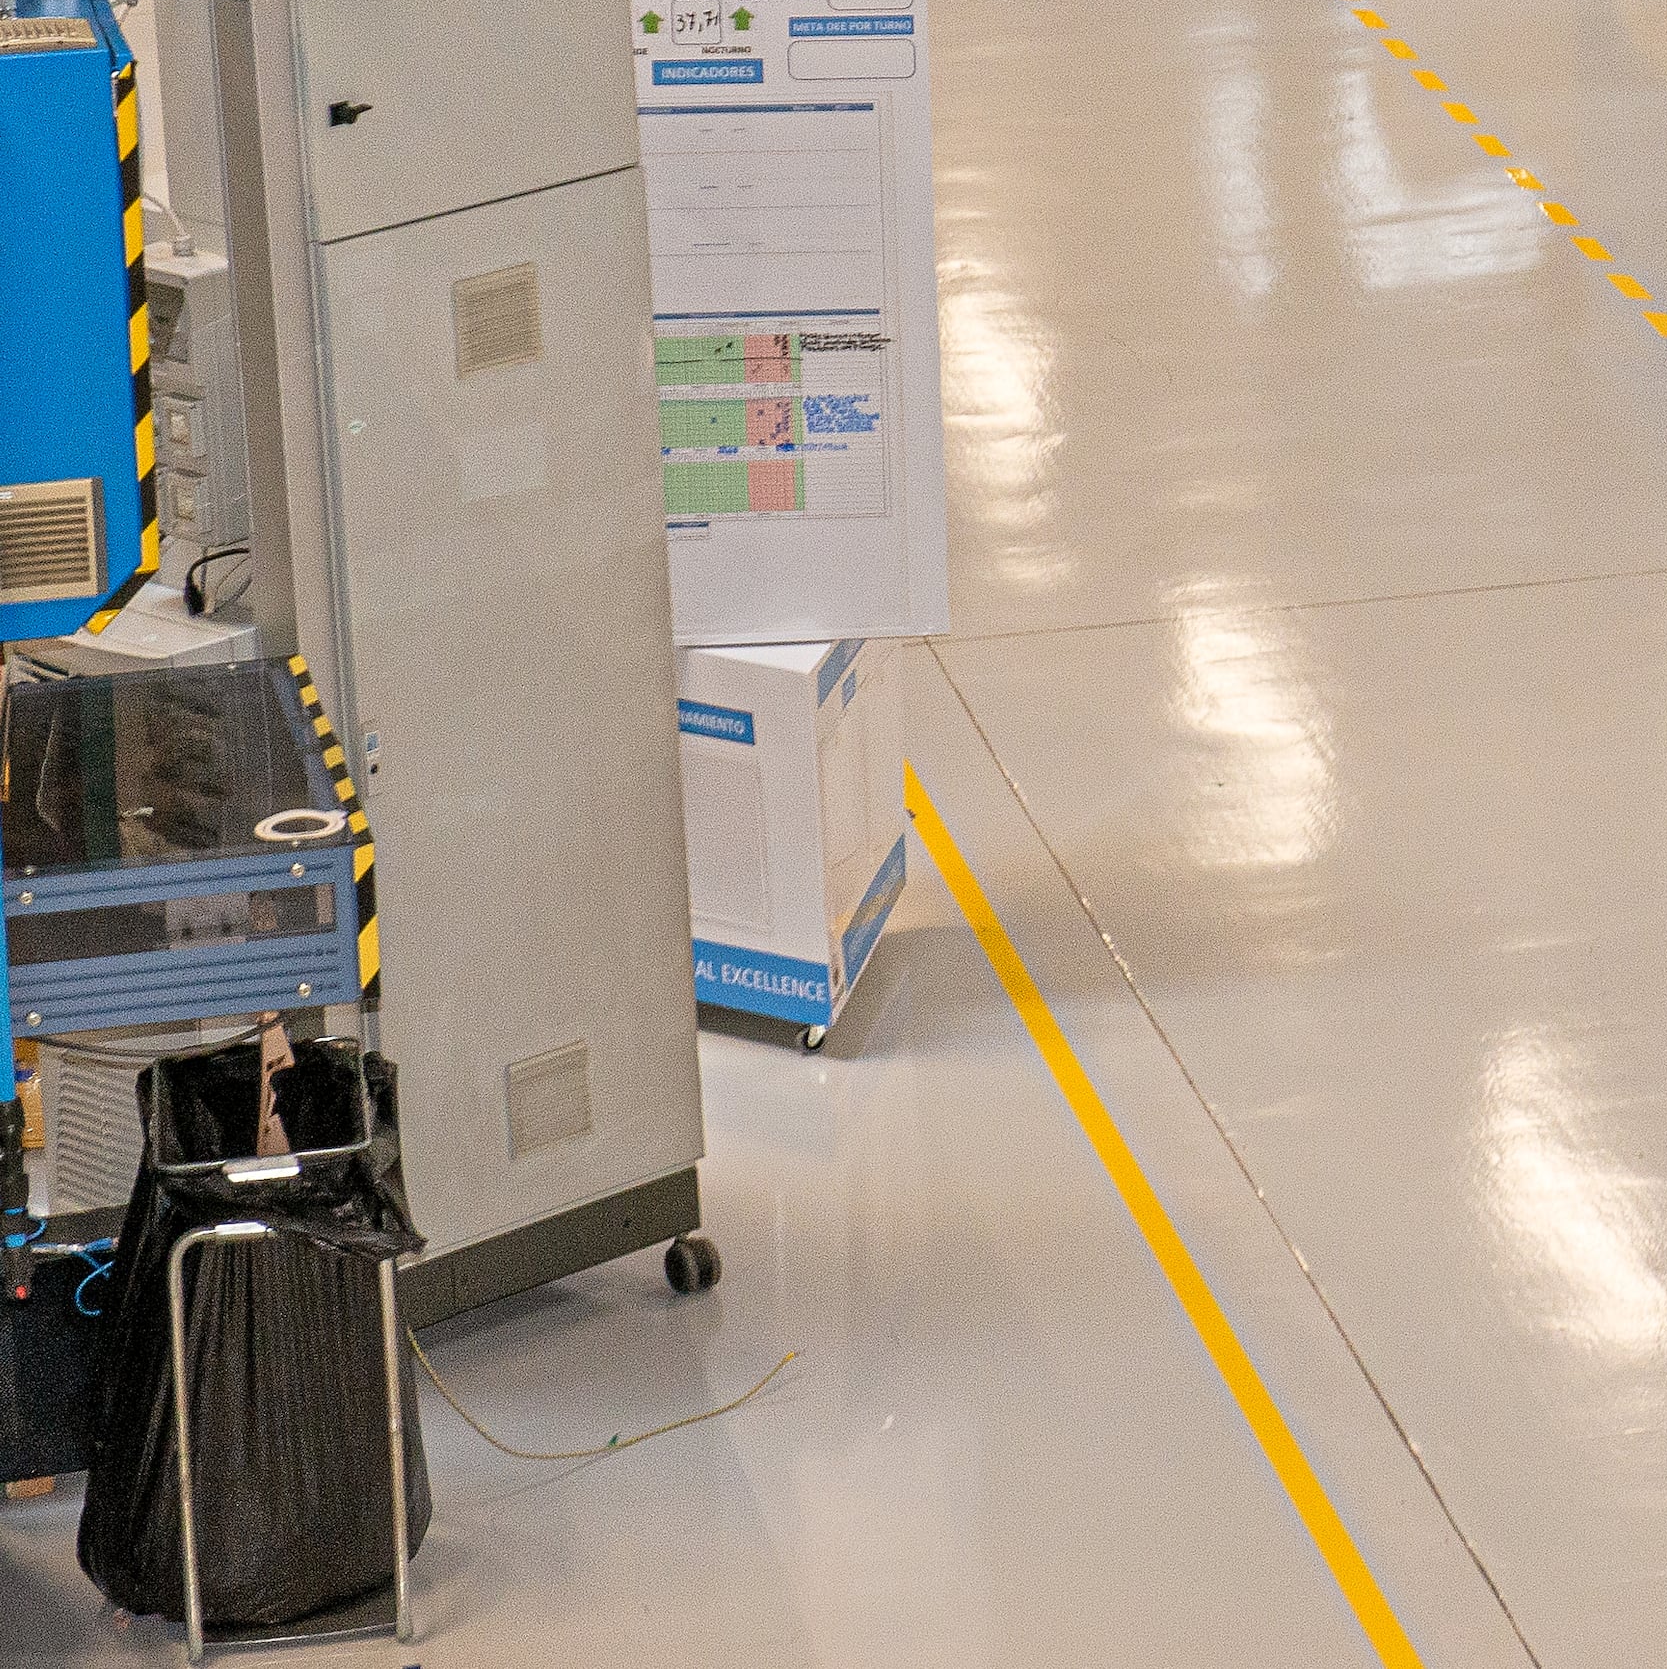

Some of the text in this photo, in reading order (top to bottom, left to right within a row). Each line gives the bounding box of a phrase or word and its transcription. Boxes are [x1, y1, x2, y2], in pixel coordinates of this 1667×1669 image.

[793, 20, 912, 32] META OEE POR TURNO
[702, 46, 752, 54] NOCTURNO
[661, 66, 756, 79] INDICADORES
[722, 964, 828, 1003] EXCELLENCE
